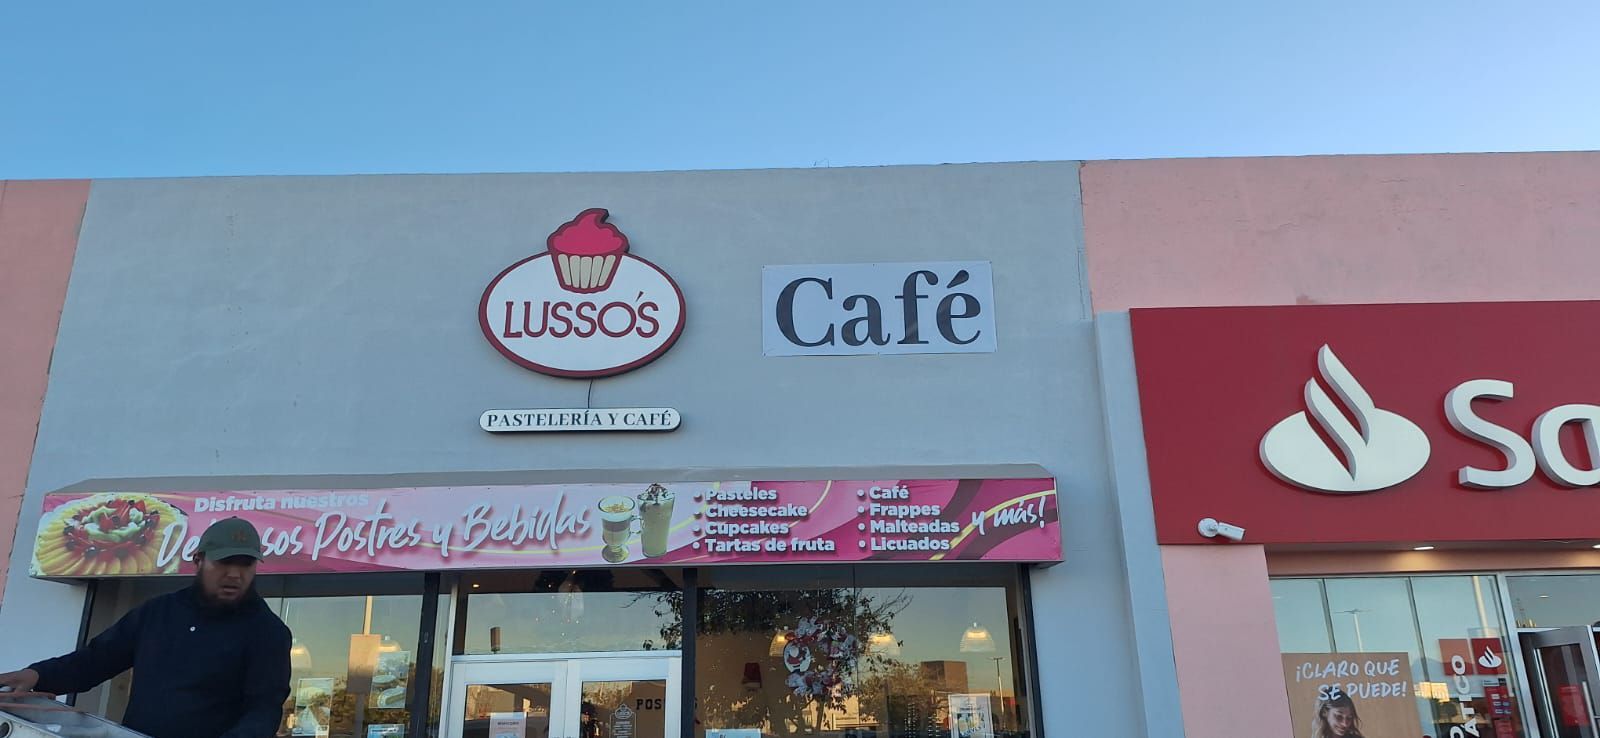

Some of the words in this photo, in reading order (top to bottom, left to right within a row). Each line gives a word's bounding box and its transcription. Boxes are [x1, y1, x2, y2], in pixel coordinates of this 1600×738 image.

[503, 291, 660, 338] LUSSO'S
[776, 270, 981, 347] Café
[487, 410, 601, 427] PASTELERÍA
[609, 412, 619, 426] Y
[623, 410, 671, 426] CAFÉ
[705, 487, 777, 501] Pasteles
[869, 485, 909, 499] Café
[194, 495, 276, 513] Disfruta
[280, 492, 369, 510] nuestros
[705, 503, 808, 518] Cheesecake
[869, 502, 941, 519] Frappes
[972, 511, 985, 535] y
[993, 495, 1046, 528] más!
[156, 519, 303, 568] Desos
[311, 499, 422, 561] Postres
[432, 521, 452, 558] y
[462, 491, 592, 551] Bebidas
[705, 521, 789, 537] Cupcakes
[870, 519, 960, 534] Malteadas
[705, 538, 761, 552] Tartas
[764, 538, 788, 551] de
[791, 537, 835, 552] fruta
[871, 536, 950, 551] Licuados
[1296, 660, 1359, 682] ¡CLARO
[1364, 659, 1400, 677] QUE
[1318, 683, 1341, 701] SE
[1346, 681, 1407, 699] PUEDE!
